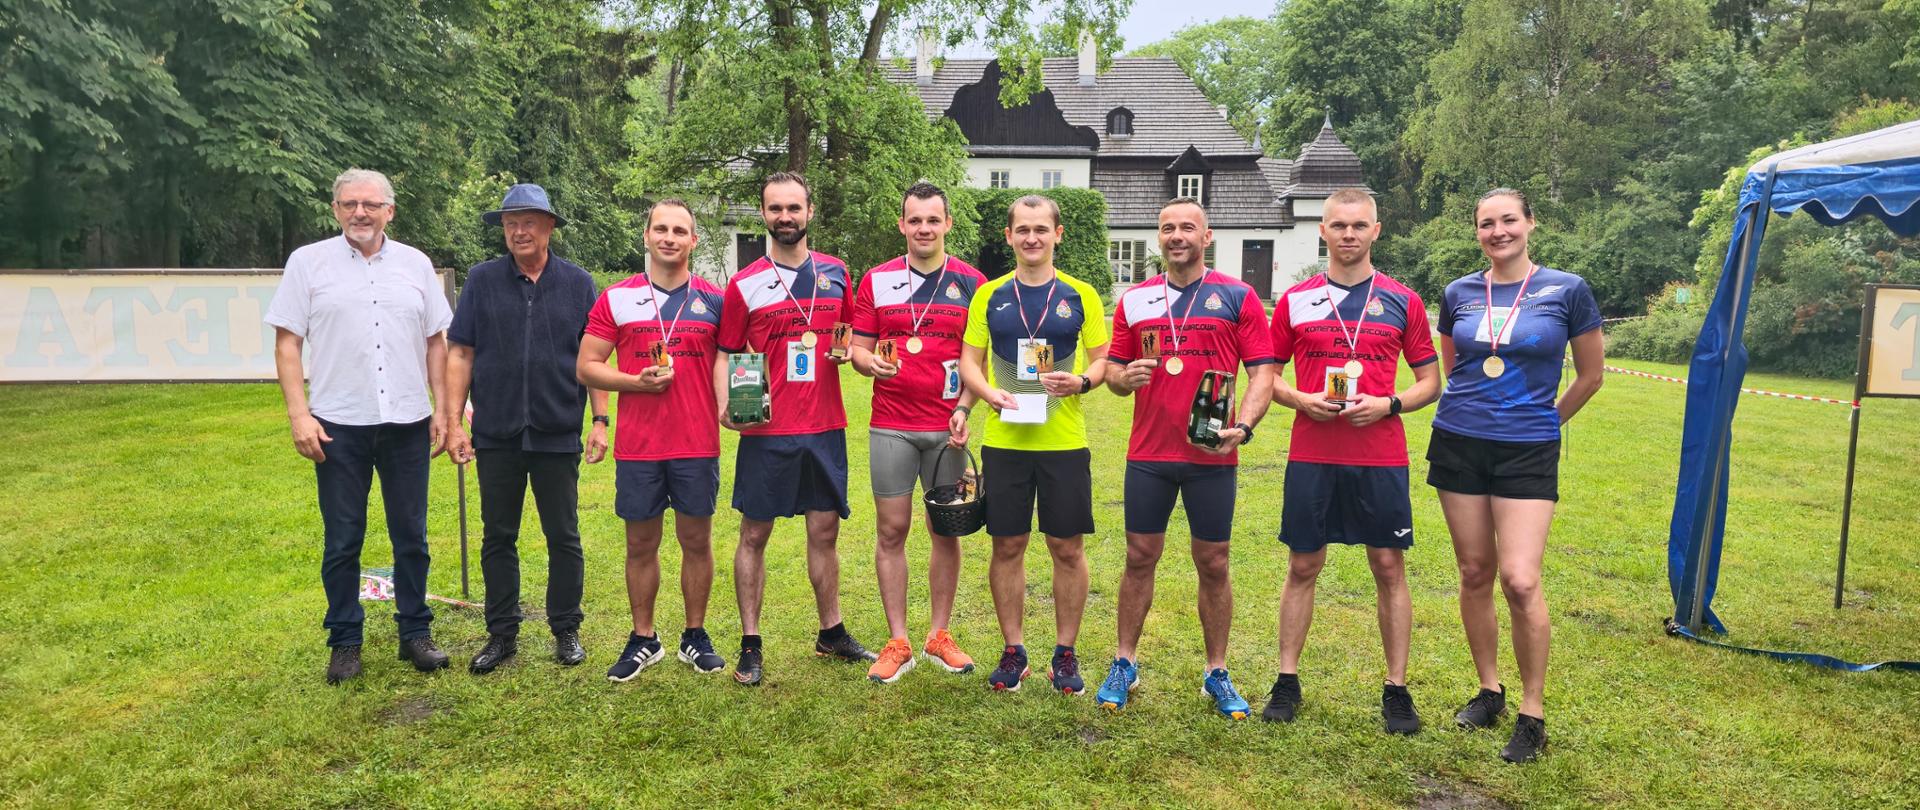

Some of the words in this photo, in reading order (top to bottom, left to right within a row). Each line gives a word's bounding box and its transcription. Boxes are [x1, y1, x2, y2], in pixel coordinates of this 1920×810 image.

[792, 316, 812, 326] PS
[660, 337, 682, 347] SP
[795, 353, 809, 376] 9
[949, 371, 959, 393] 9
